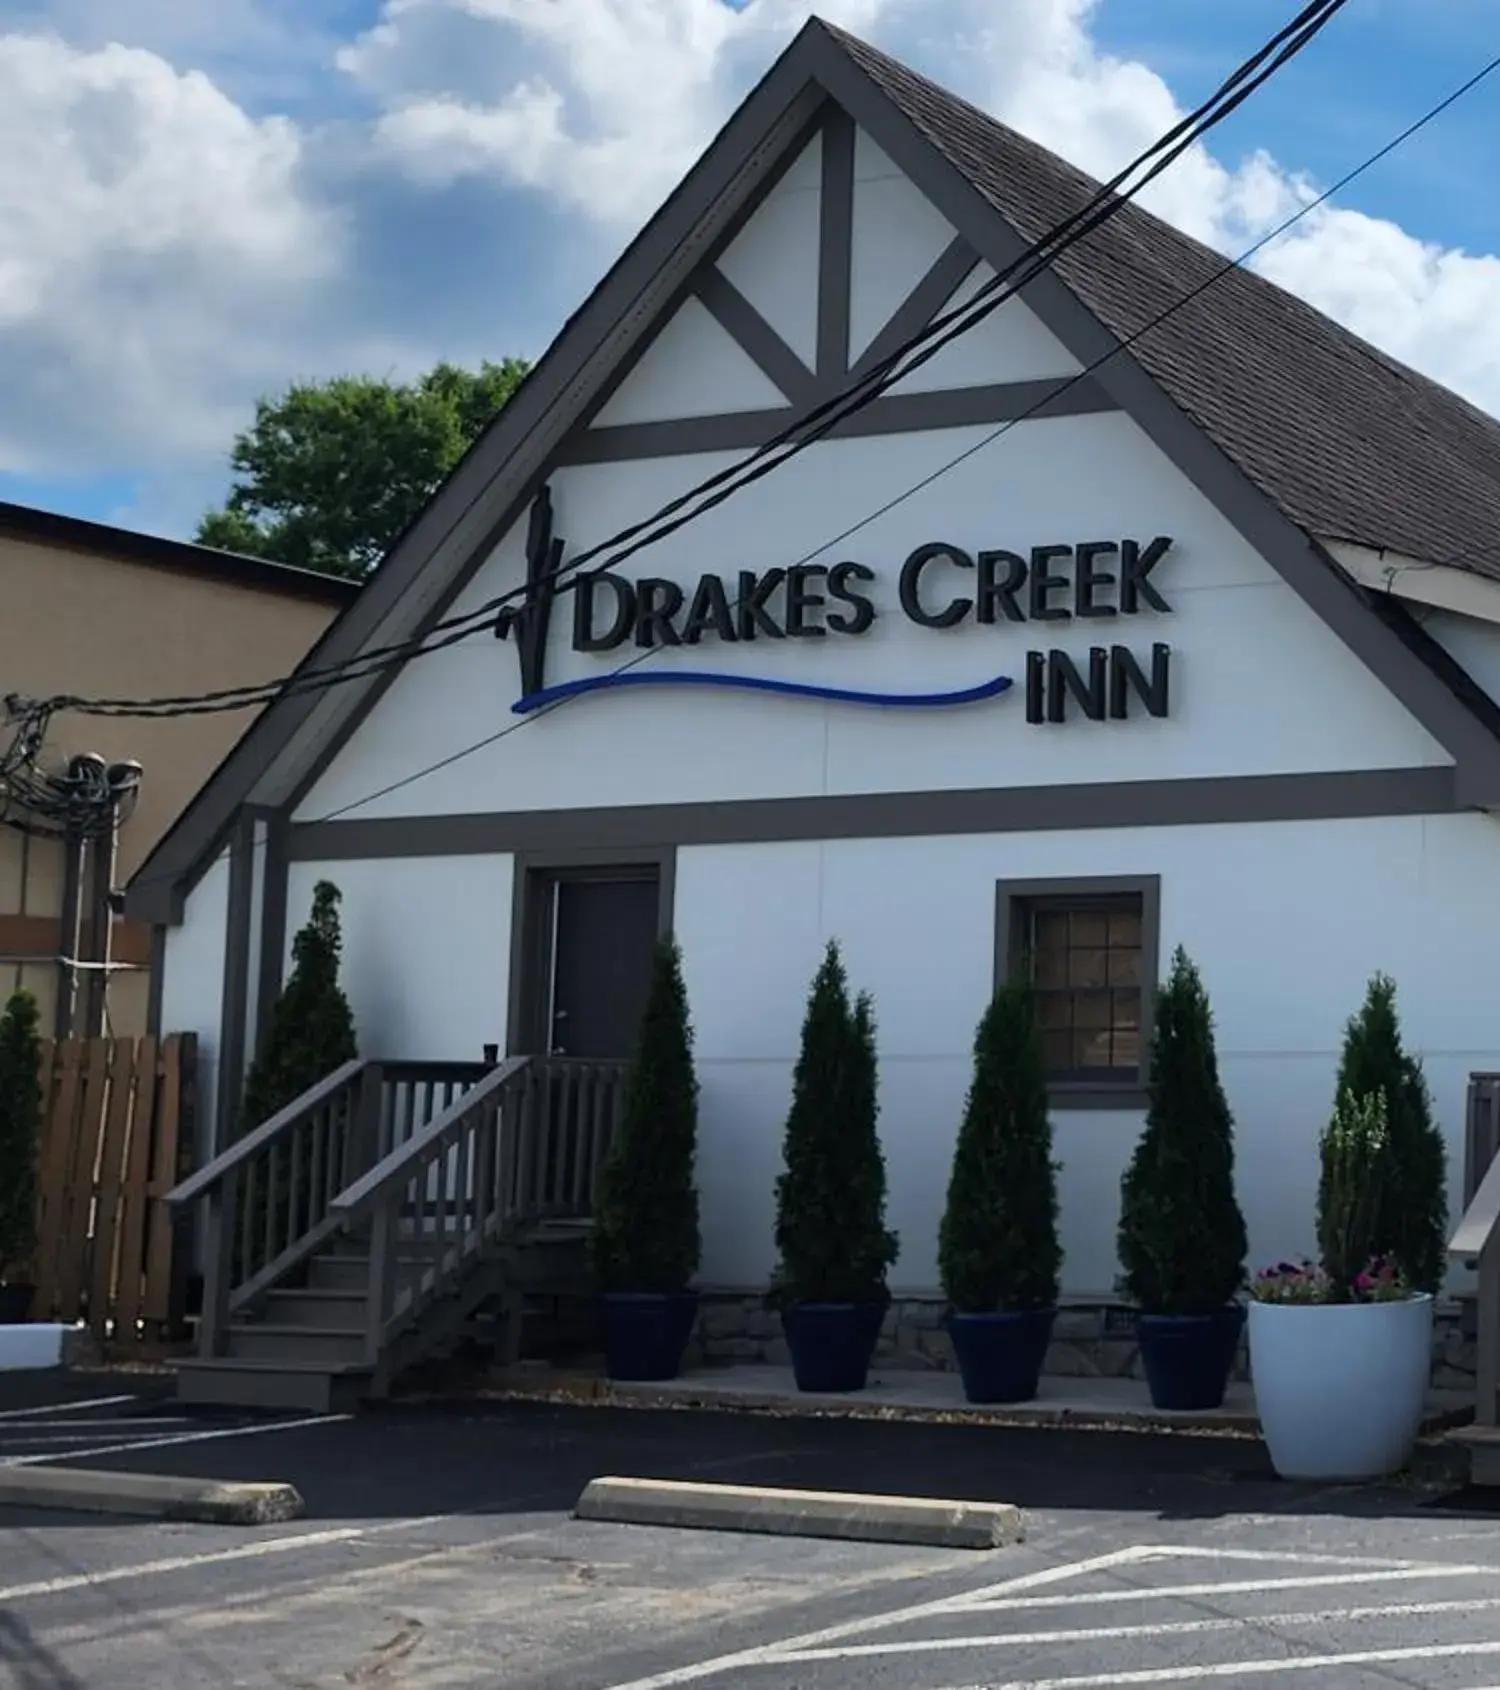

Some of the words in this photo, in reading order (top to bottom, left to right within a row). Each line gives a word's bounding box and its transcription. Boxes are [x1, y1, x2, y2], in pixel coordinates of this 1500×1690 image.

[572, 561, 876, 652] DRAKES
[899, 536, 1174, 629] CREEK
[1026, 642, 1170, 724] INN
